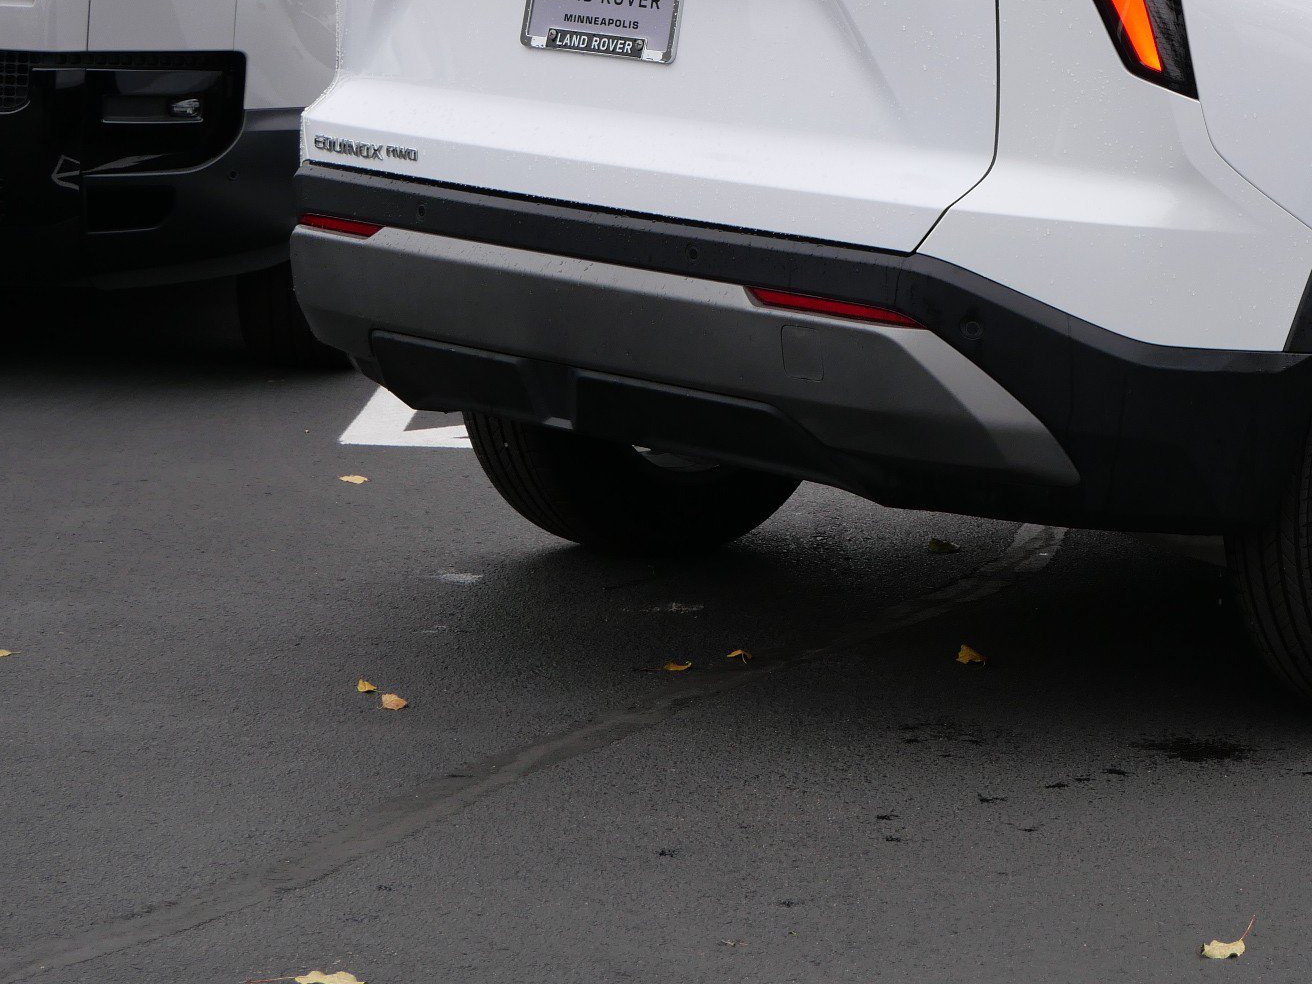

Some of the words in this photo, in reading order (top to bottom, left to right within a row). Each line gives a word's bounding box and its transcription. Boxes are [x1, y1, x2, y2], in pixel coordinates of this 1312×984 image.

[563, 13, 640, 30] MINNEAPOLIS
[556, 32, 588, 48] LAND
[591, 38, 633, 54] ROVER
[313, 134, 384, 161] EQUINOX
